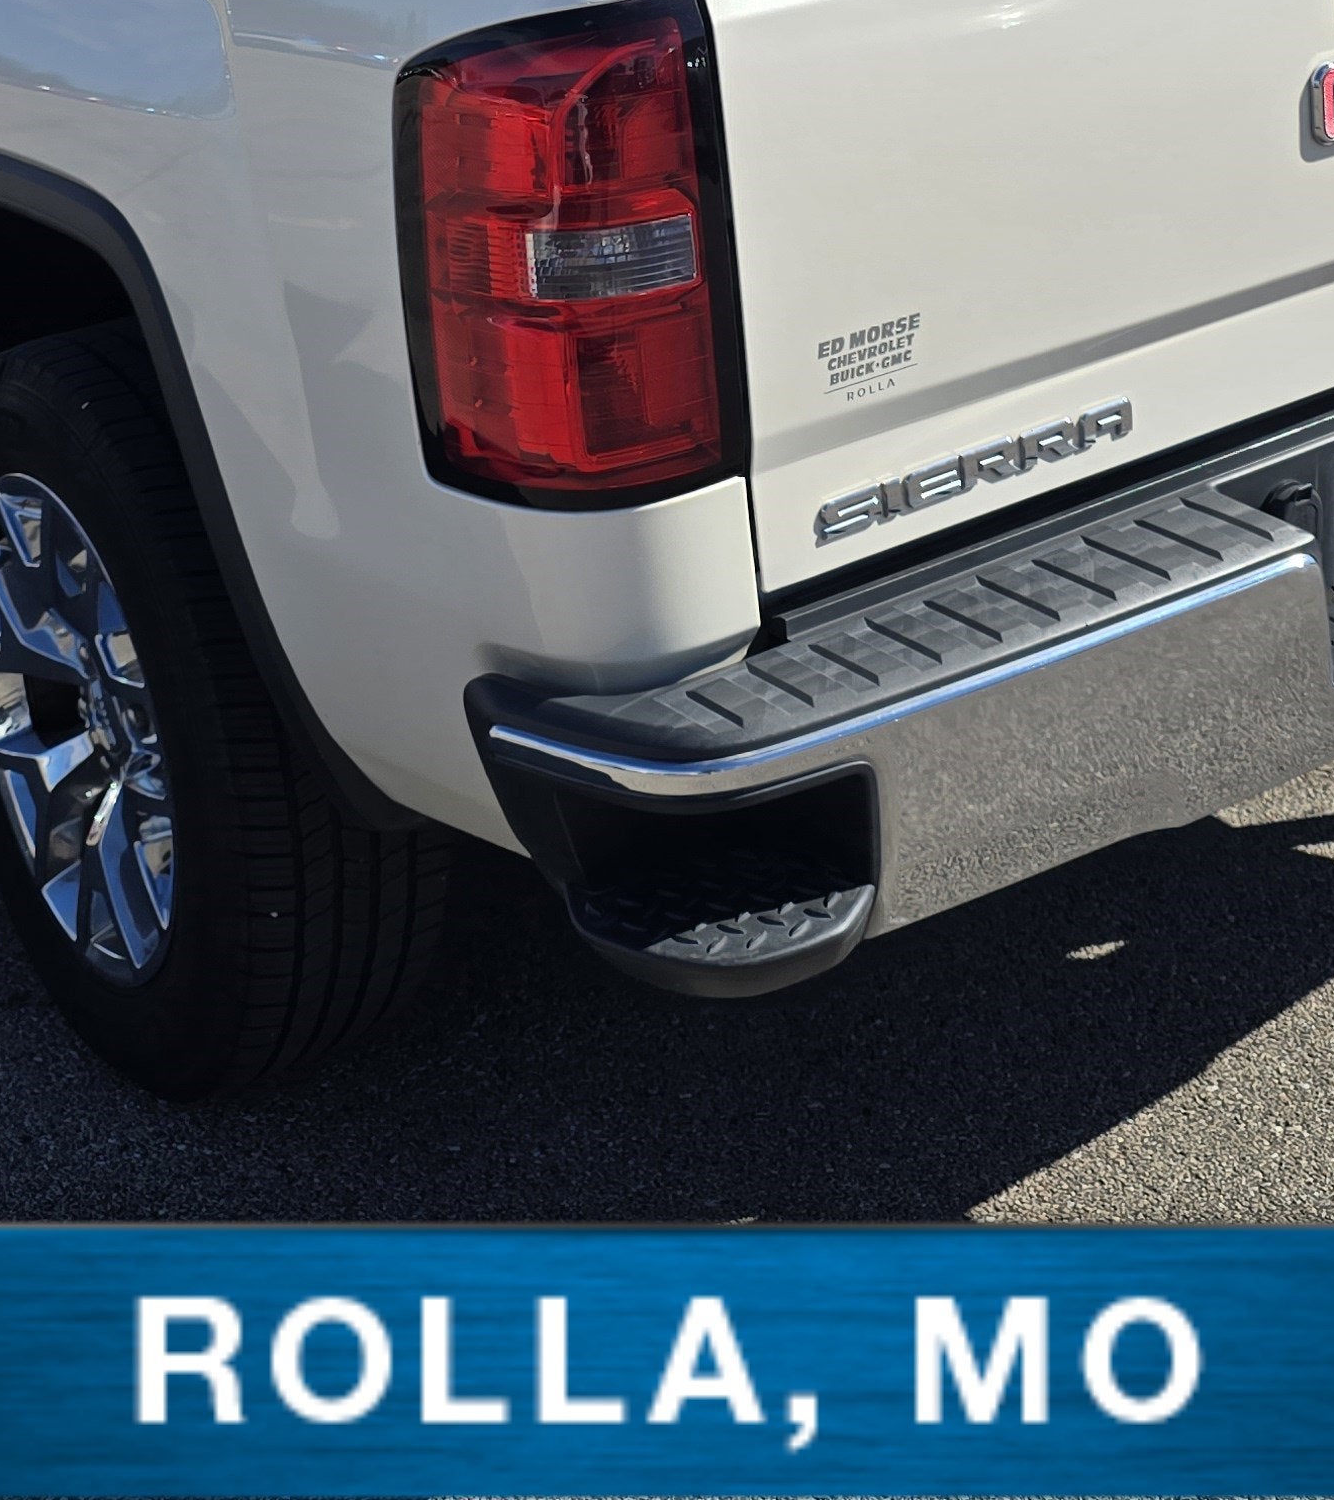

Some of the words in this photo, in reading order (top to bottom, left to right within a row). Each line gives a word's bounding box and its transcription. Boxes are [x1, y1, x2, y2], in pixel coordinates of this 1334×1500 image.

[818, 336, 845, 359] ED
[849, 313, 921, 349] MORSE
[827, 334, 915, 371] CHEVROLET
[847, 378, 896, 401] ROLLA
[814, 395, 1133, 542] SIERRA
